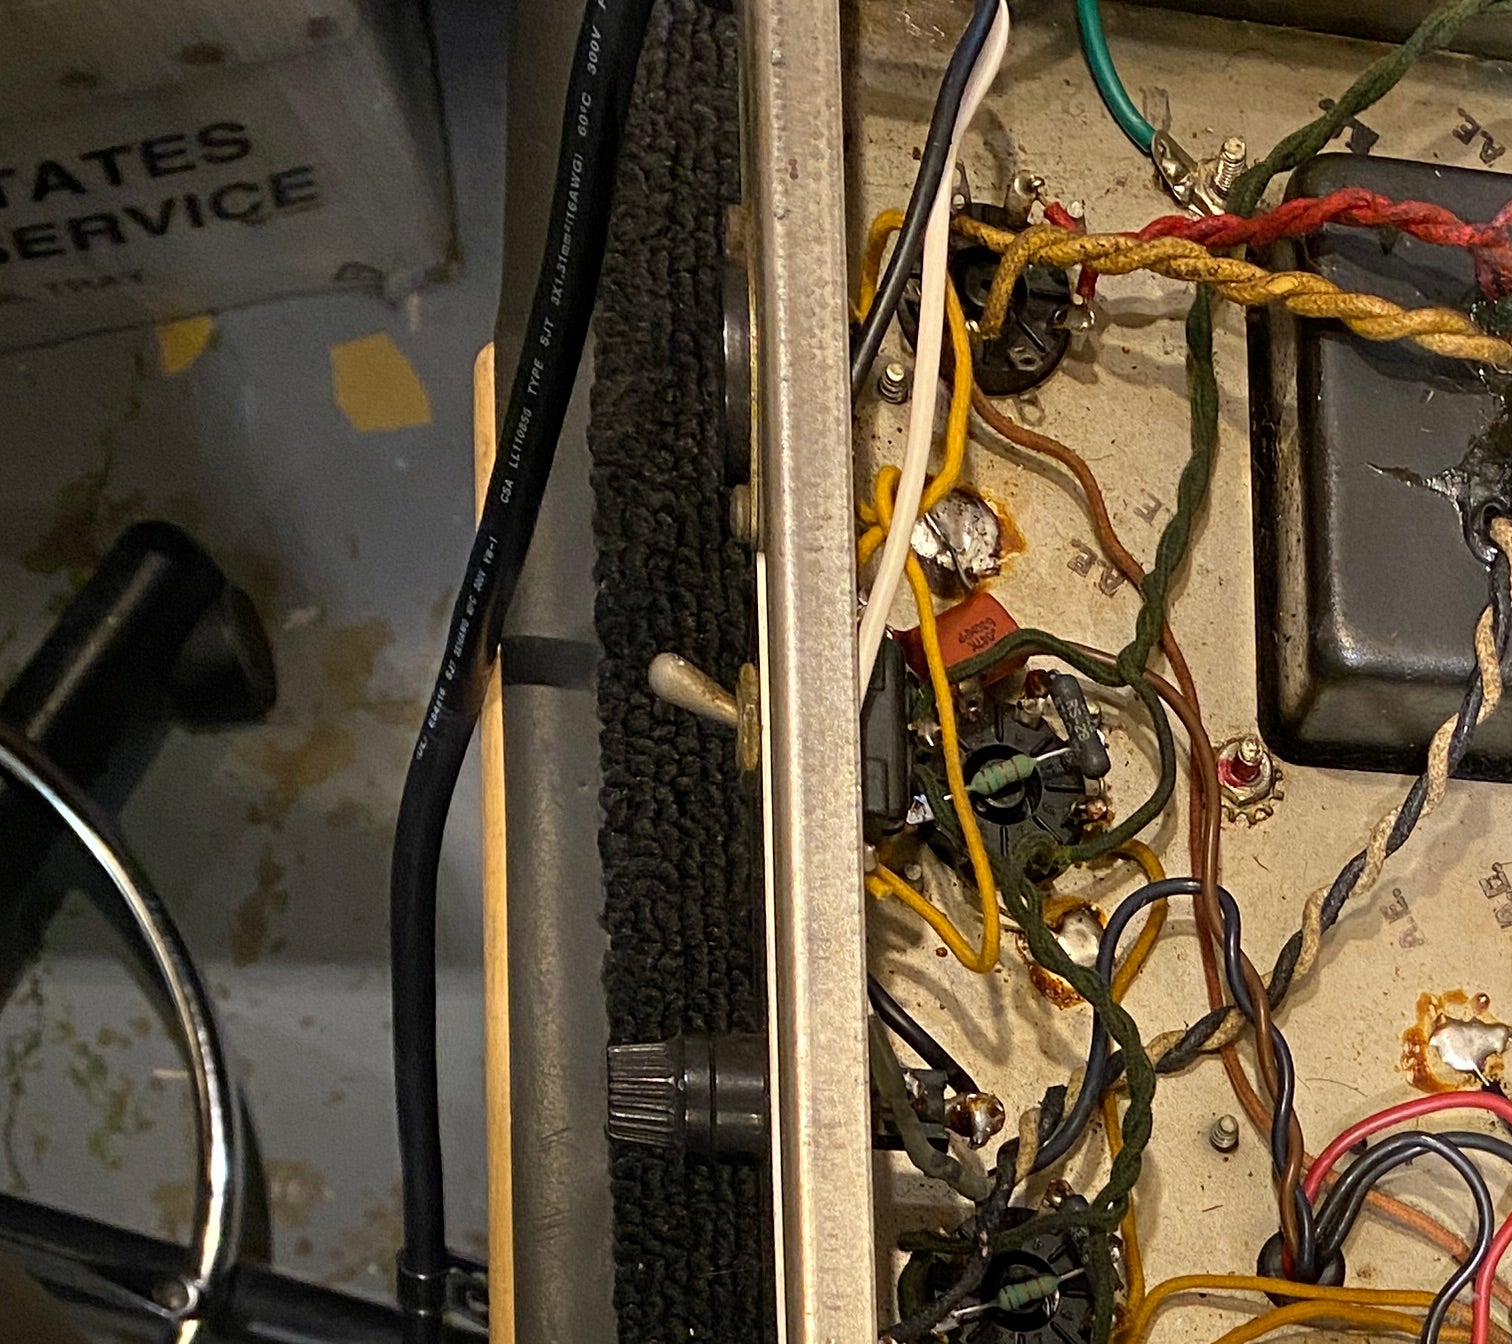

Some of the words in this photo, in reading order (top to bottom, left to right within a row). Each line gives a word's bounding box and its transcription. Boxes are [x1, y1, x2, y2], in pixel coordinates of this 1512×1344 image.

[0, 122, 251, 209] ATES
[0, 165, 319, 264] ERVICE
[500, 479, 515, 504] CSA
[527, 357, 545, 396] TYPE
[540, 315, 555, 347] SJT
[587, 25, 601, 76] 300V
